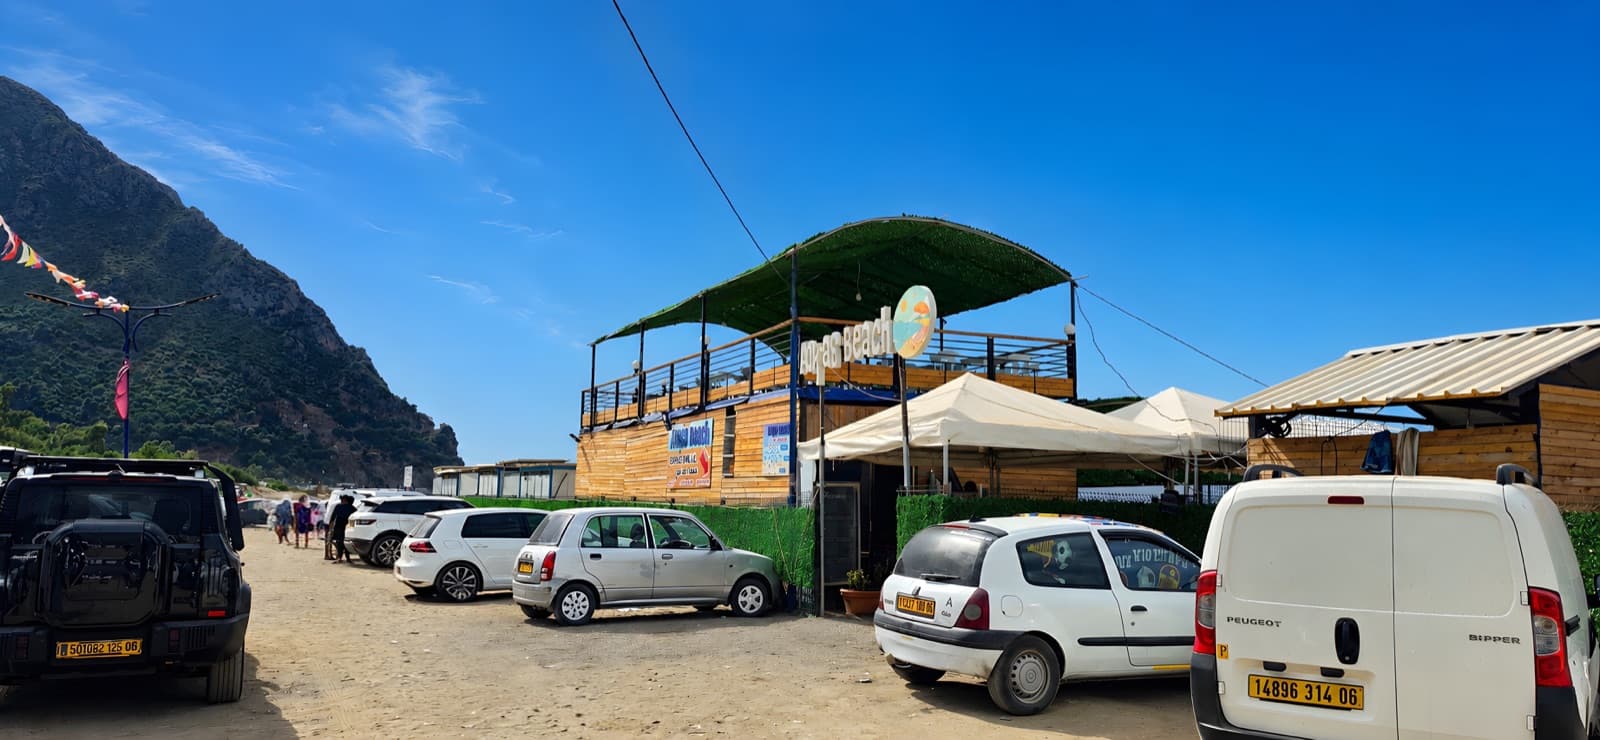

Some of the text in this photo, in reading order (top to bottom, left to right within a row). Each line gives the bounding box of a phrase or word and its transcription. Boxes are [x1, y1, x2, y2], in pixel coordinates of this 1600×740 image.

[1227, 616, 1282, 628] PEUGEOT
[1469, 634, 1521, 645] BIPPER
[125, 641, 138, 652] 06
[1220, 644, 1228, 657] P
[1255, 678, 1358, 706] 14896 314 06
